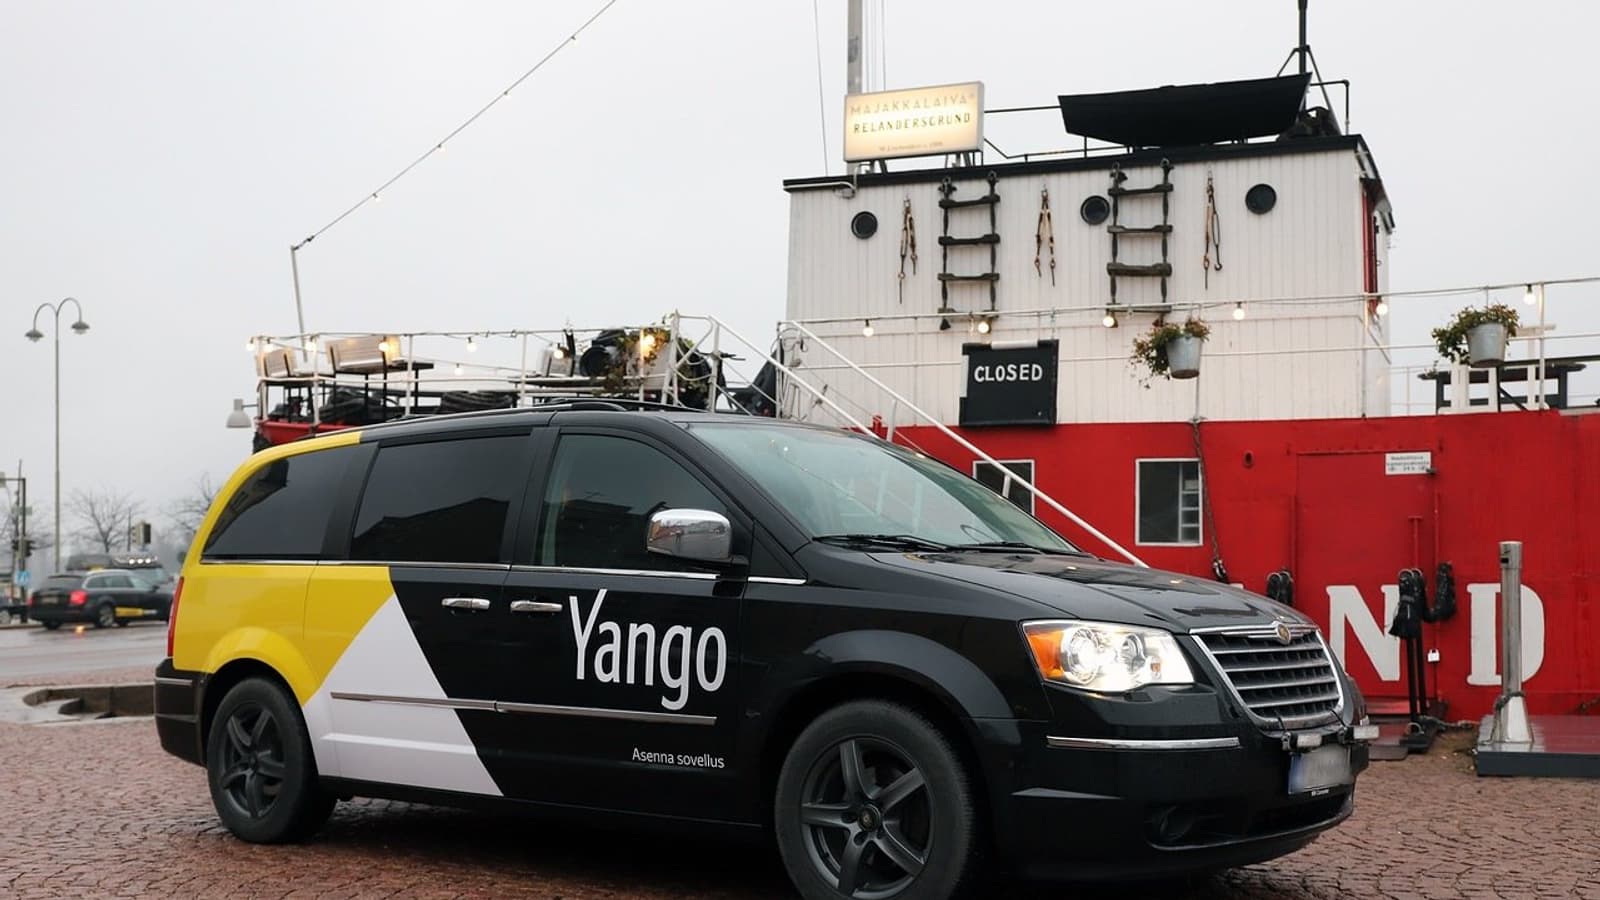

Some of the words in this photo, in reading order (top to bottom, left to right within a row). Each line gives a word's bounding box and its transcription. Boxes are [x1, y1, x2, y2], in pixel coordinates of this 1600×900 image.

[974, 363, 1043, 382] CLOSED
[569, 588, 727, 711] Yango
[632, 747, 674, 765] Asenna
[676, 753, 725, 769] sovellus
